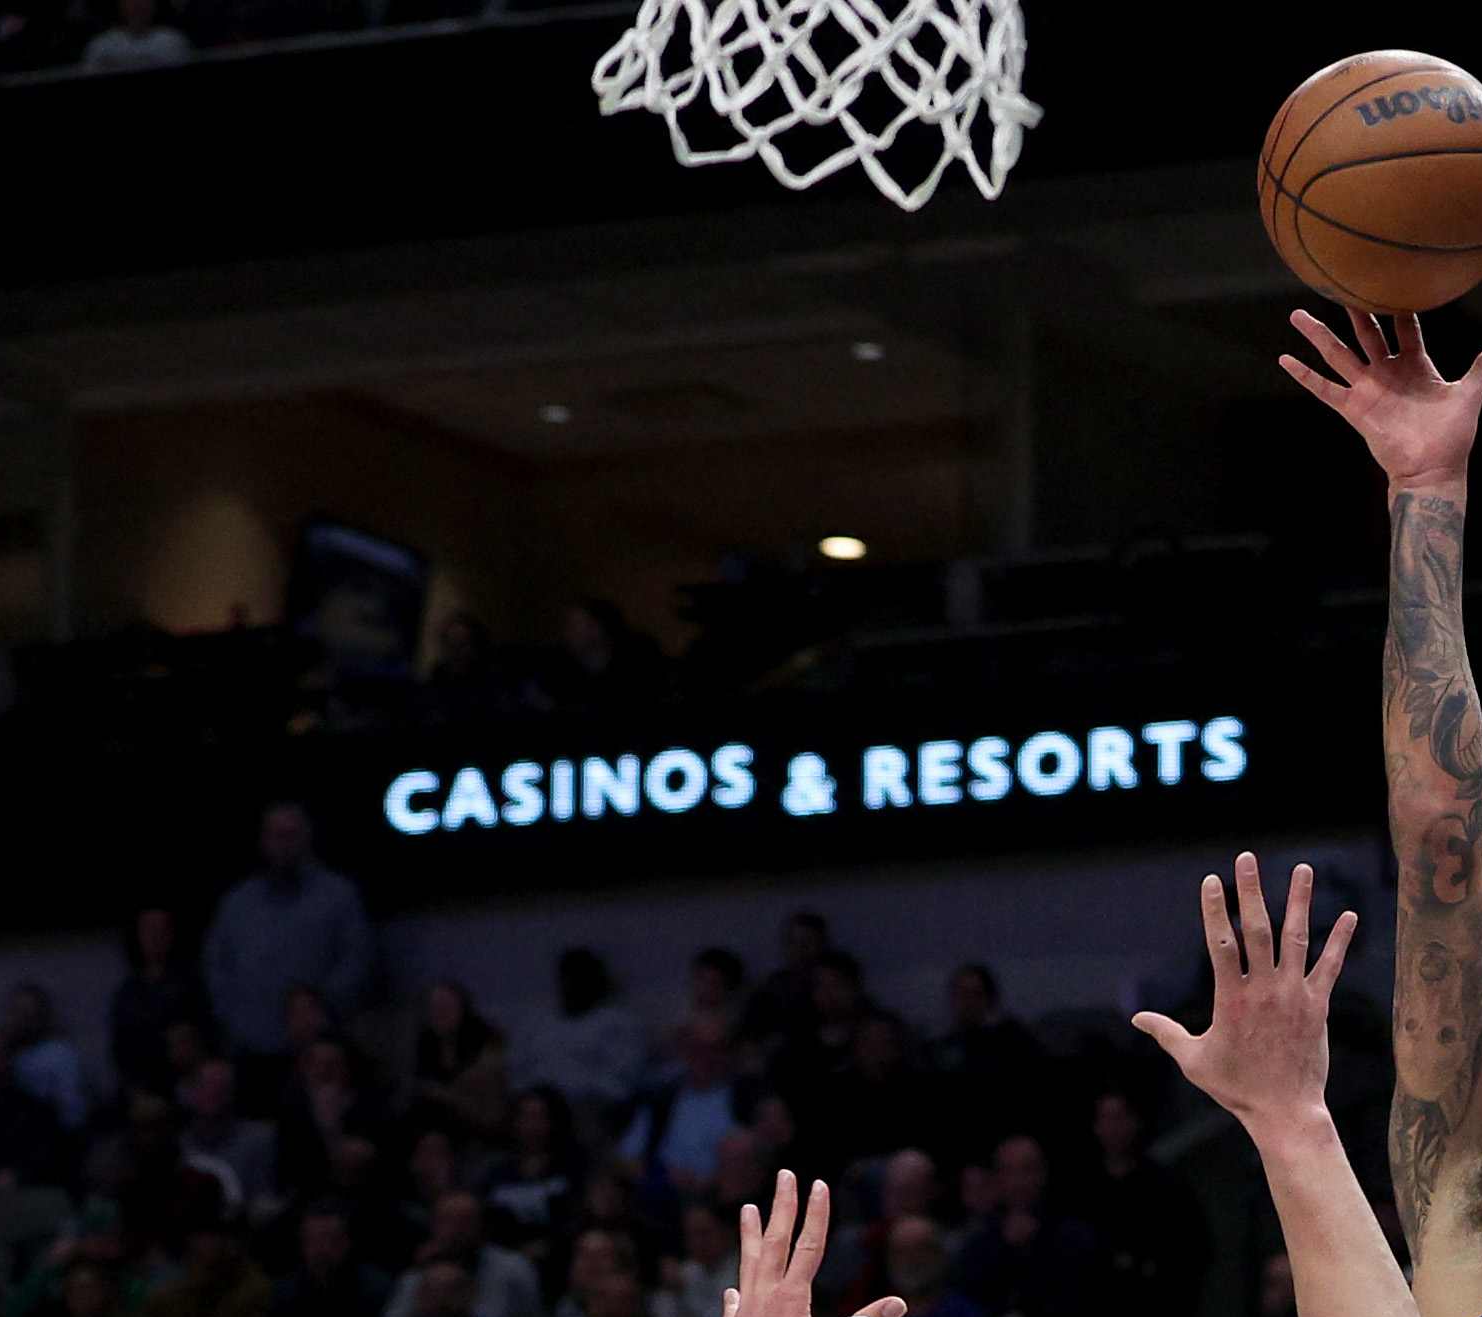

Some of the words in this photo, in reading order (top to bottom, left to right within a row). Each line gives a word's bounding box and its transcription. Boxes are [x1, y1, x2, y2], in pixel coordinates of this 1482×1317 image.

[382, 741, 755, 838] CASINOS
[780, 751, 838, 818] &
[860, 715, 1250, 812] RESORTS
